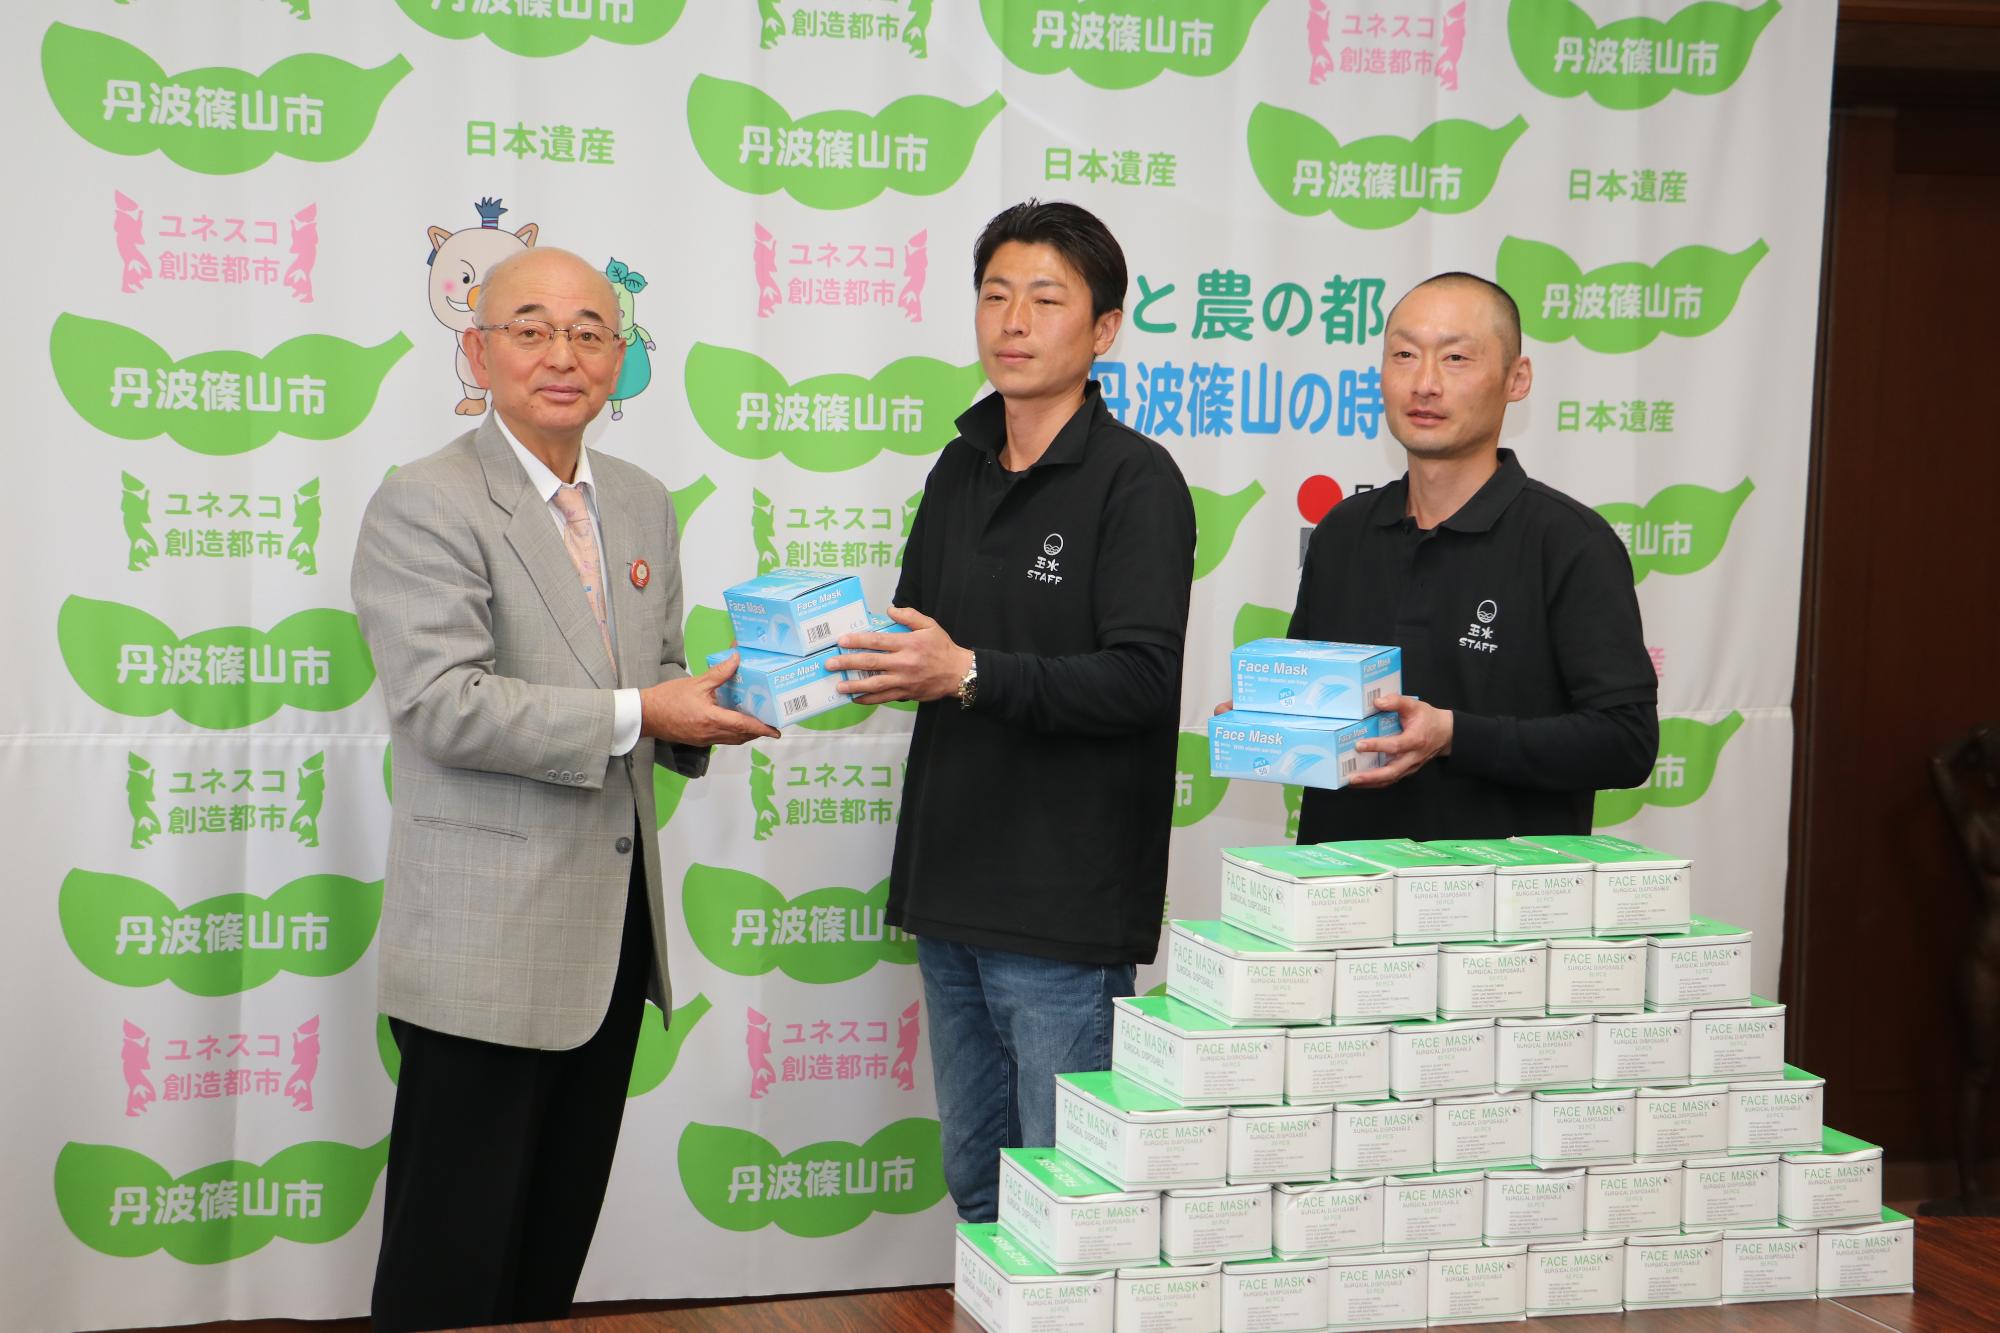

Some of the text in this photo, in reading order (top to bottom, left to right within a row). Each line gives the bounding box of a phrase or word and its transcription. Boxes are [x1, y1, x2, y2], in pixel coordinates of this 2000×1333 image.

[790, 9, 900, 42] 創造都市
[1031, 9, 1214, 57] 丹波篠山市
[1340, 13, 1436, 39] ユネスコ
[1339, 46, 1436, 75] 創造都市
[1553, 35, 1719, 78] 丹波篠山市
[102, 79, 324, 136] 丹波篠山市
[465, 120, 616, 166] 日本遺産
[738, 126, 929, 173] 丹波篠山市
[1042, 147, 1178, 187] 日本遺産
[1291, 159, 1463, 202] 丹波篠山市
[1567, 168, 1688, 204] 日本遺産
[158, 214, 280, 245] ユネスコ
[787, 242, 896, 269] ユネスコ
[157, 250, 281, 286] 創造都市
[786, 277, 896, 306] 創造都市
[1132, 269, 1386, 345] と農の都
[1541, 283, 1702, 321] 丹波篠山市
[109, 366, 327, 416] 丹波篠山市
[735, 392, 925, 434] 丹波篠山市
[1556, 400, 1675, 434] 日本遺産
[164, 490, 282, 520] ユネスコ
[786, 505, 892, 531] ユネスコ
[164, 527, 285, 559] 創造都市
[785, 540, 893, 568] 創造都市
[1026, 569, 1063, 585] STAFF
[796, 599, 817, 611] Face
[819, 589, 842, 603] Mask
[1458, 637, 1499, 654] STAFF
[116, 642, 331, 688] 丹波篠山市
[774, 673, 795, 685] Face
[797, 661, 820, 676] Mask
[1237, 659, 1309, 676] Face Mask
[1214, 726, 1284, 745] Face Mask
[166, 767, 287, 796] ユネスコ
[786, 763, 892, 788] ユネスコ
[166, 803, 288, 837] 創造都市
[785, 798, 893, 825] 創造都市
[1226, 871, 1274, 904] FACE MASK
[1410, 879, 1475, 893] FACE MASK
[1511, 877, 1575, 891] FACE MASK
[1608, 874, 1673, 887] FACE MASK
[1307, 886, 1373, 899] FACE MASK
[114, 910, 330, 956] 丹波篠山市
[1462, 955, 1529, 969] FACE MASK
[1563, 951, 1628, 965] FACE MASK
[1670, 948, 1733, 963] FACE MASK
[1247, 965, 1313, 977] FACE MASK
[1349, 960, 1415, 974] FACE MASK
[782, 1017, 888, 1046] ユネスコ
[1513, 1029, 1576, 1043] FACE MASK
[1609, 1025, 1673, 1040] FACE MASK
[1704, 1021, 1769, 1035] FACE MASK
[163, 1031, 282, 1063] ユネスコ
[1196, 1041, 1263, 1055] FACE MASK
[1303, 1039, 1370, 1054] FACE MASK
[1411, 1034, 1475, 1049] FACE MASK
[781, 1052, 889, 1081] 創造都市
[162, 1068, 282, 1102] 創造都市
[1649, 1100, 1712, 1113] FACE MASK
[1740, 1093, 1805, 1105] FACE MASK
[1448, 1106, 1512, 1121] FACE MASK
[1553, 1104, 1617, 1118] FACE MASK
[1245, 1120, 1312, 1134] FACE MASK
[1349, 1113, 1415, 1128] FACE MASK
[1139, 1125, 1207, 1139] FACE MASK
[727, 1155, 915, 1204] 丹波篠山市
[1699, 1169, 1760, 1184] FACE MASK
[1804, 1165, 1866, 1180] FACE MASK
[1501, 1182, 1566, 1195] FACE MASK
[1600, 1176, 1663, 1190] FACE MASK
[108, 1178, 323, 1226] 丹波篠山市
[1296, 1194, 1363, 1208] FACE MASK
[1398, 1187, 1463, 1201] FACE MASK
[1070, 1206, 1140, 1220] FACE MASK
[1184, 1199, 1251, 1214] FACE MASK
[1735, 1241, 1799, 1255] FACE MASK
[1831, 1235, 1894, 1250] FACE MASK
[1540, 1253, 1604, 1267] FACE MASK
[1640, 1248, 1704, 1262] FACE MASK
[1339, 1267, 1407, 1283] FACE MASK
[1441, 1261, 1505, 1276] FACE MASK
[1130, 1280, 1200, 1296] FACE MASK
[1239, 1277, 1306, 1290] FACE MASK
[1023, 1285, 1092, 1300] FACE MASK
